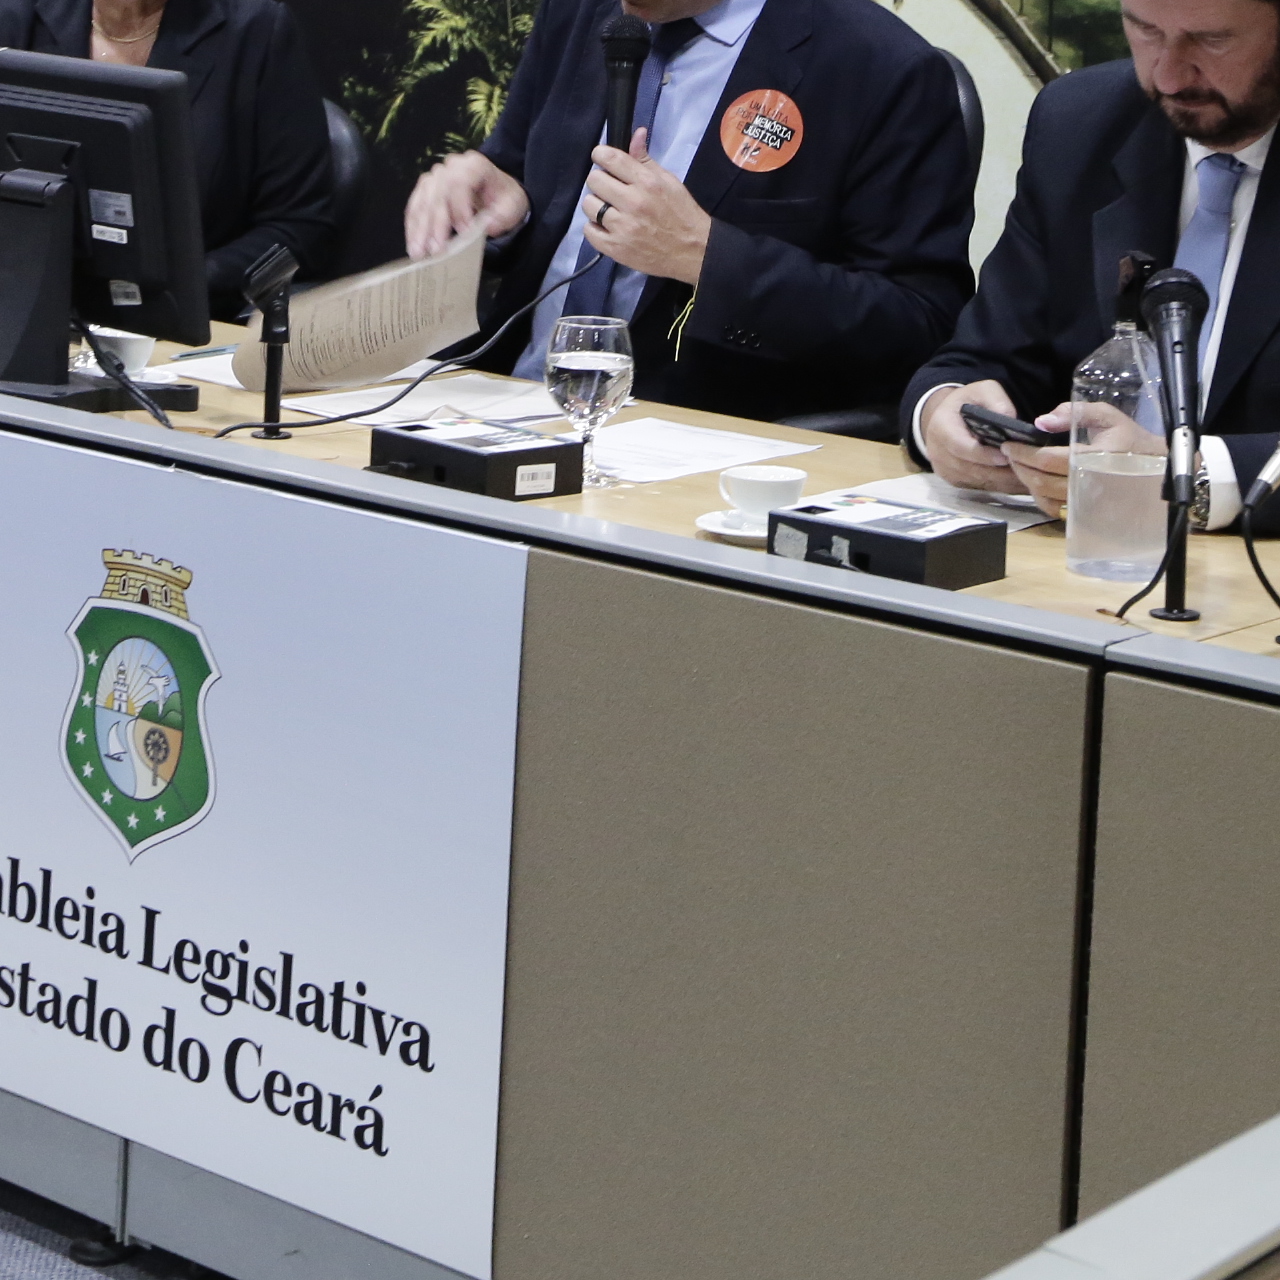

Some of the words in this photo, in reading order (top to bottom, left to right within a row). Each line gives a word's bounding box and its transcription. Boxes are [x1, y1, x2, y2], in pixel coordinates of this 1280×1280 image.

[737, 108, 753, 120] POR
[753, 114, 792, 141] MEMÓRIA
[737, 121, 744, 131] E
[744, 125, 781, 149] JUSTIÇA
[137, 905, 435, 1073] Legislativa
[142, 1006, 210, 1084] do
[224, 1037, 389, 1157] Ceará
